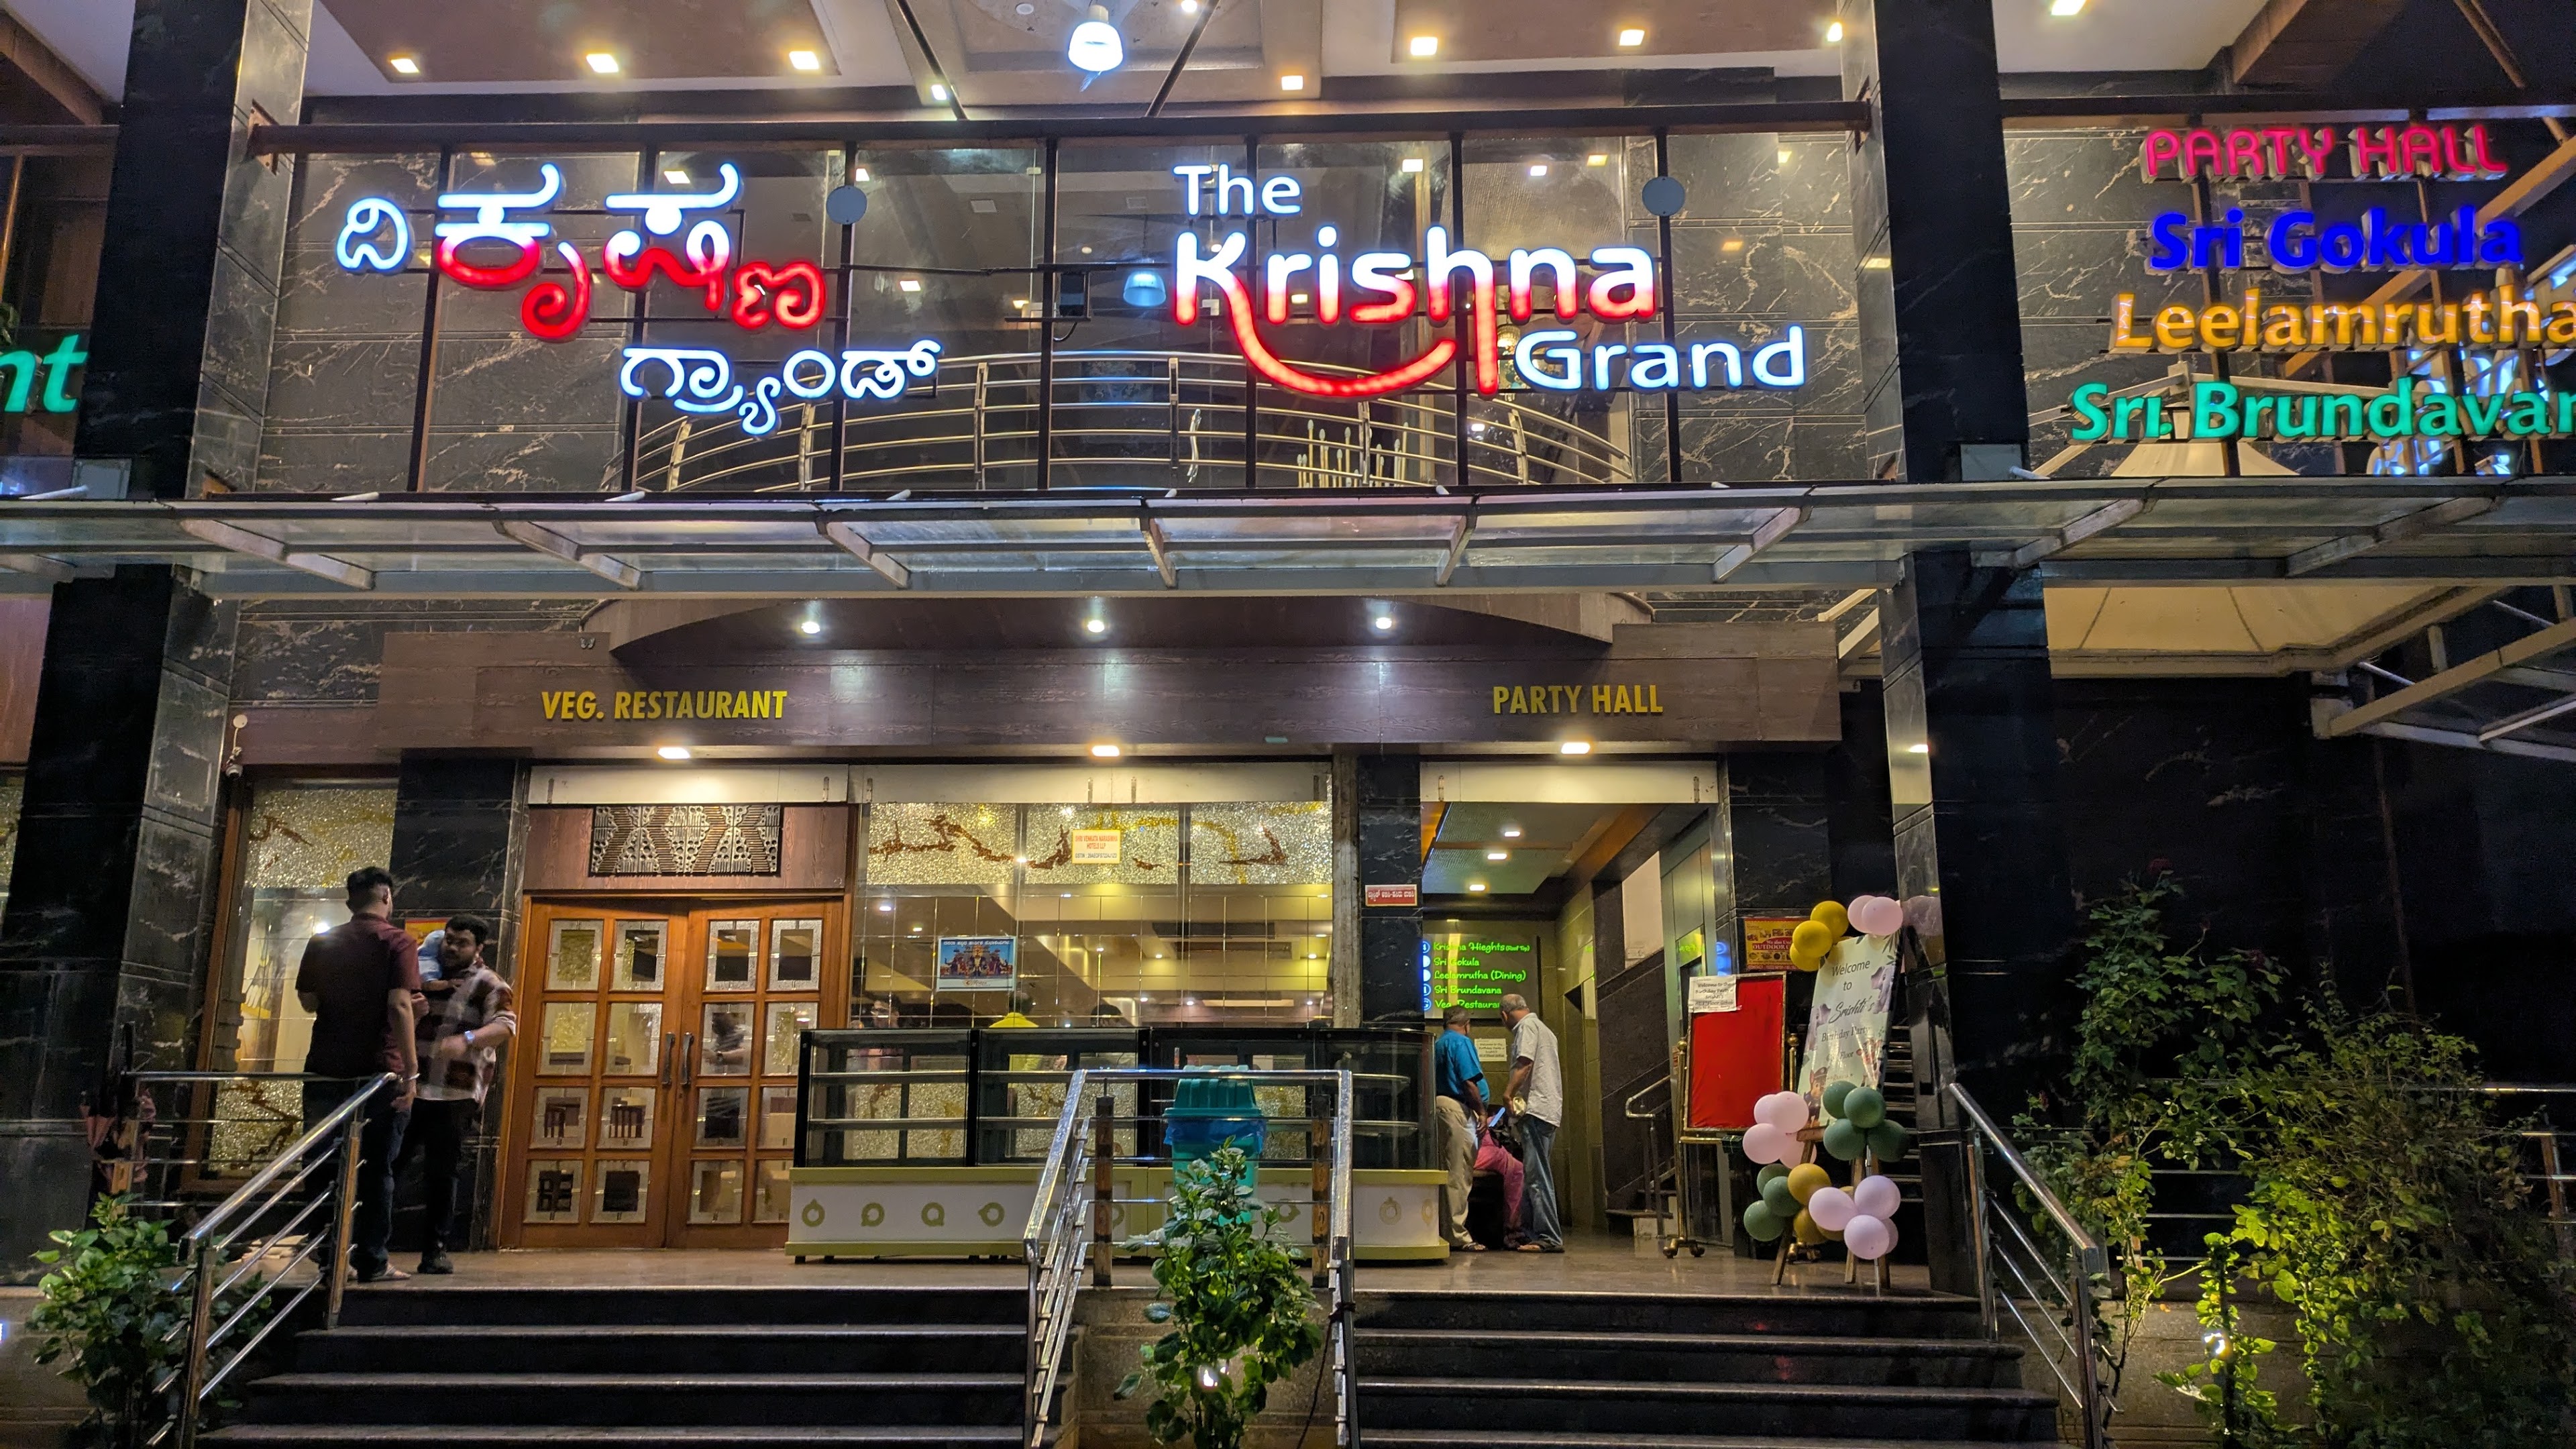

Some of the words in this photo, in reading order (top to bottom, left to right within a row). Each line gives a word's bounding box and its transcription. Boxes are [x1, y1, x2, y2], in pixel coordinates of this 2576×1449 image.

[2147, 127, 2335, 176] PARTY
[2356, 125, 2508, 174] HALL
[1173, 163, 1302, 216] The
[336, 197, 409, 270] ದಿ
[435, 163, 826, 340] ಕೃಷ್ಣ
[2149, 208, 2244, 269] Sri
[2269, 206, 2523, 268] Gokula
[1174, 224, 1657, 398] Krishna
[2114, 284, 2576, 348] Leelamrutha
[1513, 325, 1806, 392] Grand
[541, 691, 604, 719] VEG.
[614, 690, 788, 719] RESTAURANT
[1493, 685, 1582, 714] PARTY
[1592, 684, 1664, 714] HALL
[1434, 942, 1466, 951] Krisna
[1434, 957, 1447, 966] Sri
[1450, 957, 1480, 966] Gokula
[1434, 970, 1489, 979] Leelamrutha
[1491, 970, 1526, 982] (Dining)
[1832, 961, 1870, 976] Welcome
[1434, 985, 1447, 994] Sri
[1450, 985, 1502, 994] Brundavana
[1843, 981, 1852, 991] to
[1457, 999, 1499, 1008] Restaura
[1821, 1029, 1849, 1042] Birthday
[1851, 1026, 1870, 1036] Party
